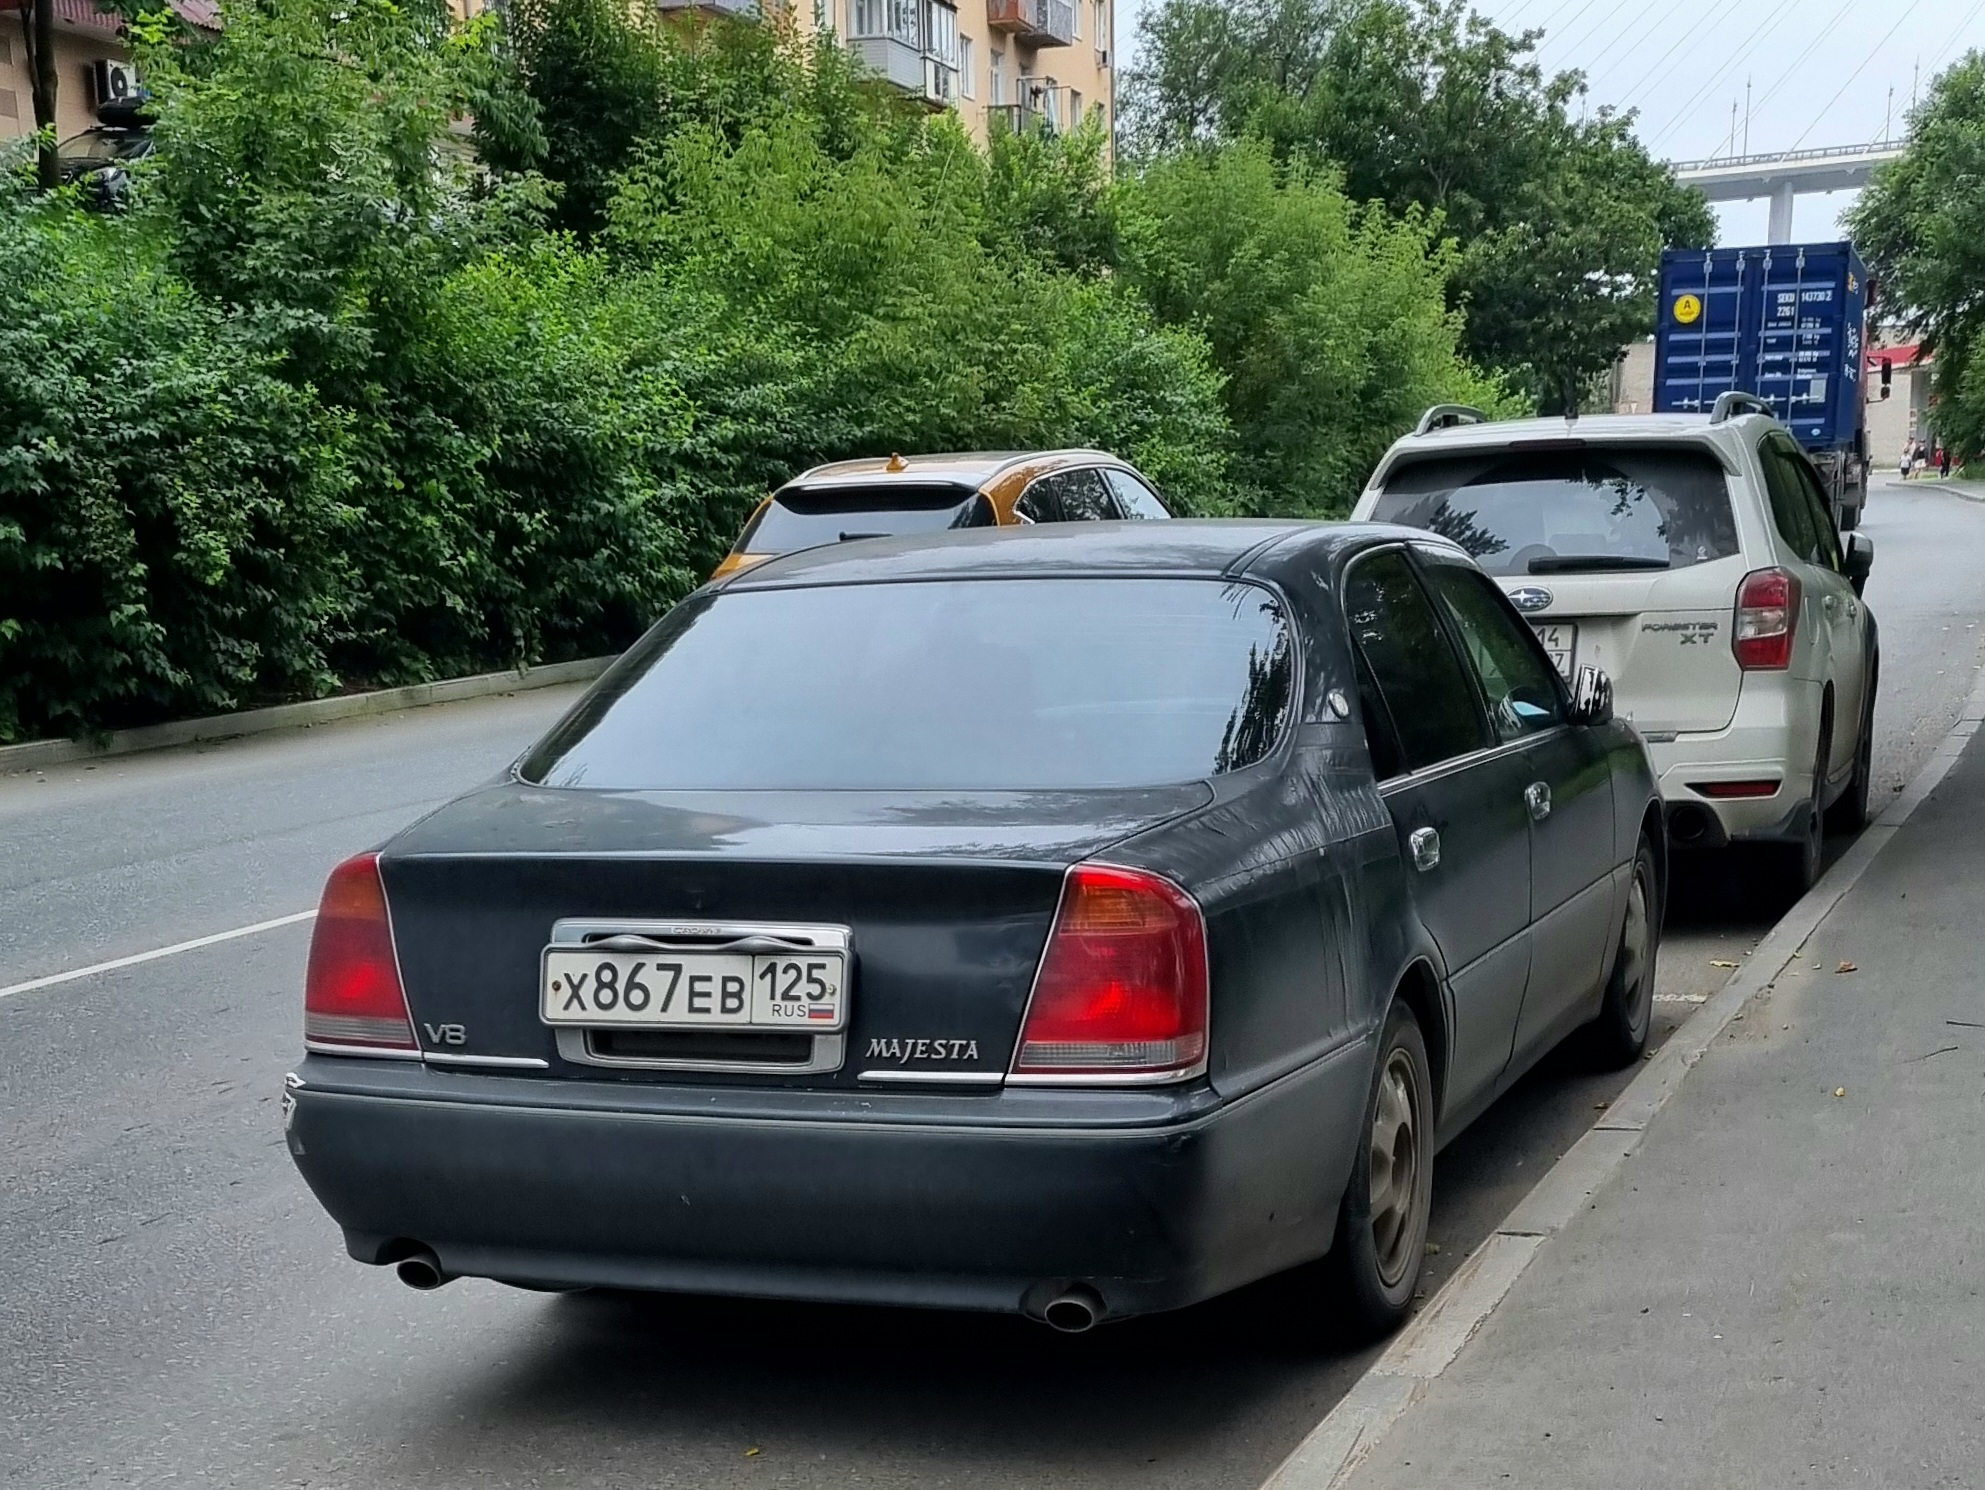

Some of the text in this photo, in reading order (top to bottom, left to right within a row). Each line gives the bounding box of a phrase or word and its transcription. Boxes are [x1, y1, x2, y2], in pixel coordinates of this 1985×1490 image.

[1680, 632, 1714, 644] XT
[758, 961, 827, 1001] 125
[771, 1003, 807, 1018] RUS
[424, 1023, 466, 1045] V8
[865, 1039, 978, 1064] MAJESTA
